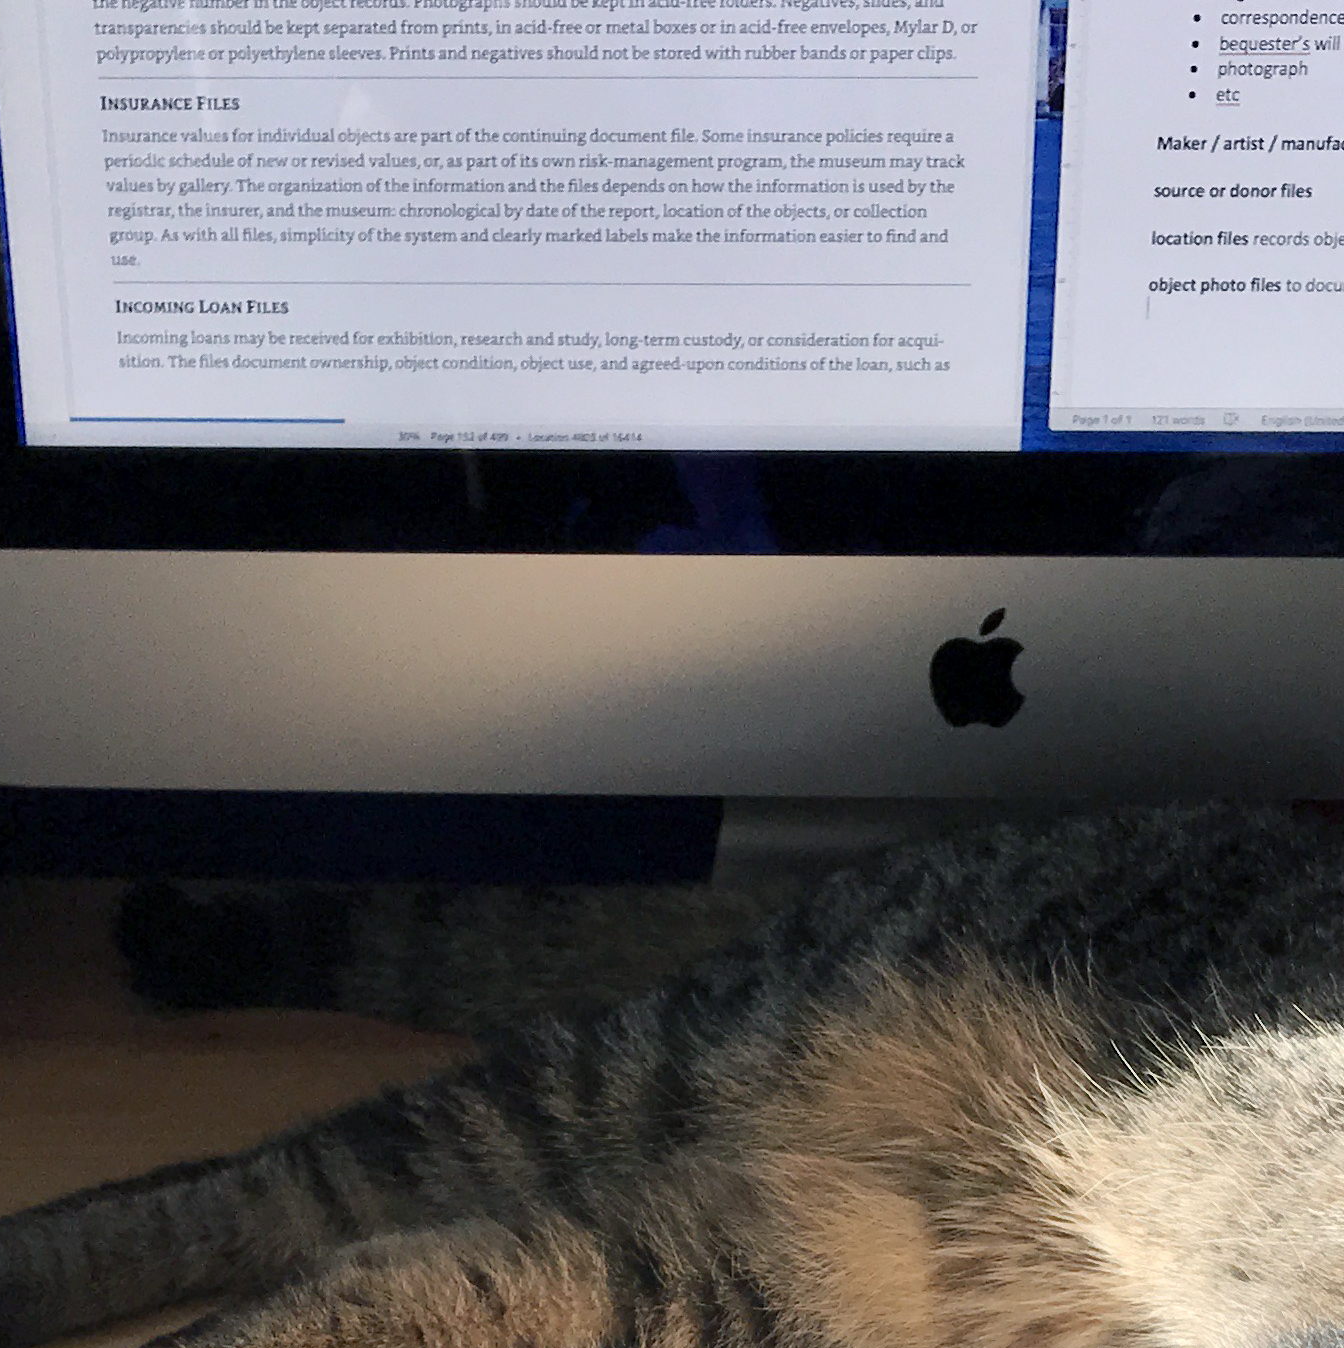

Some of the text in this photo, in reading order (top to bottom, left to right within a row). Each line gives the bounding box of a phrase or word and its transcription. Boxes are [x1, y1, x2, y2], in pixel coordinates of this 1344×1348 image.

[94, 19, 979, 39] transparencies should be kept separated from prints, in acid-free or metal boxes or in acid-free envelopes, Mylar D, or
[1219, 35, 1341, 53] bequester's will
[1217, 60, 1309, 80] photograph
[1215, 87, 1241, 102] etc
[101, 128, 955, 148] Insurance values for individual objects are part of the continuing document file. Some insurance policies require a
[1156, 135, 1208, 152] Maker
[1222, 136, 1265, 152] artist
[1153, 182, 1313, 199] source or donor files
[1151, 230, 1214, 247] location
[1216, 230, 1250, 247] files
[1252, 230, 1310, 247] records
[1148, 276, 1197, 297] object
[1199, 276, 1247, 297] photo
[1250, 276, 1282, 293] files
[1286, 278, 1302, 293] to
[117, 330, 945, 352] Incoming loans may be received for exhibition, research and study, long-term custody, or consideration for acqui-
